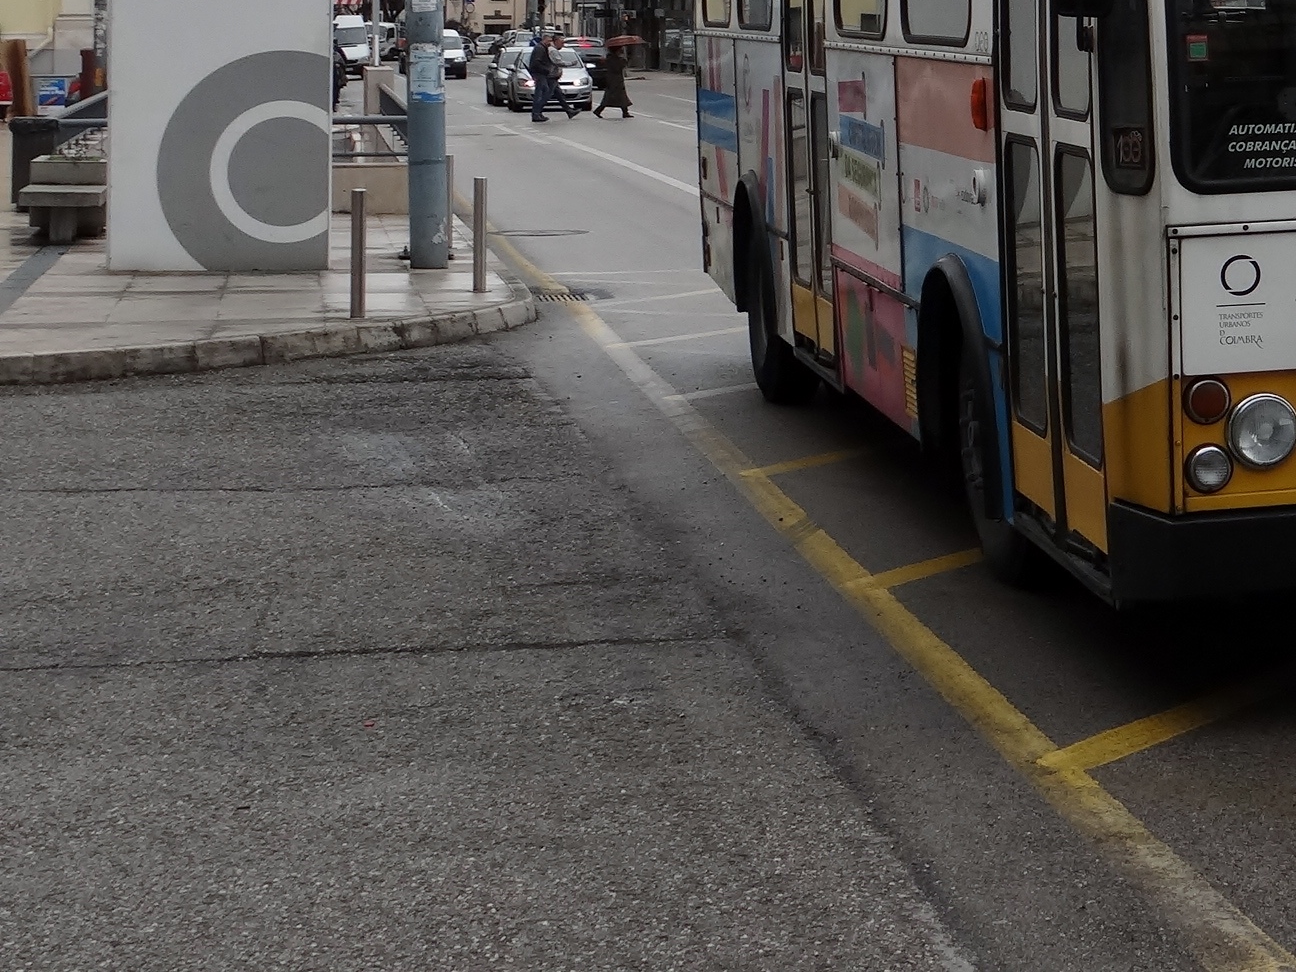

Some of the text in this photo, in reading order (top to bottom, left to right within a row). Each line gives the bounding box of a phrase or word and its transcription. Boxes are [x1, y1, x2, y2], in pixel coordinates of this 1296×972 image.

[1227, 139, 1296, 154] COBRANÇA
[1219, 311, 1264, 321] TRANSPORTES
[1219, 320, 1252, 329] URBANOS
[1219, 335, 1264, 349] COIMBRA
